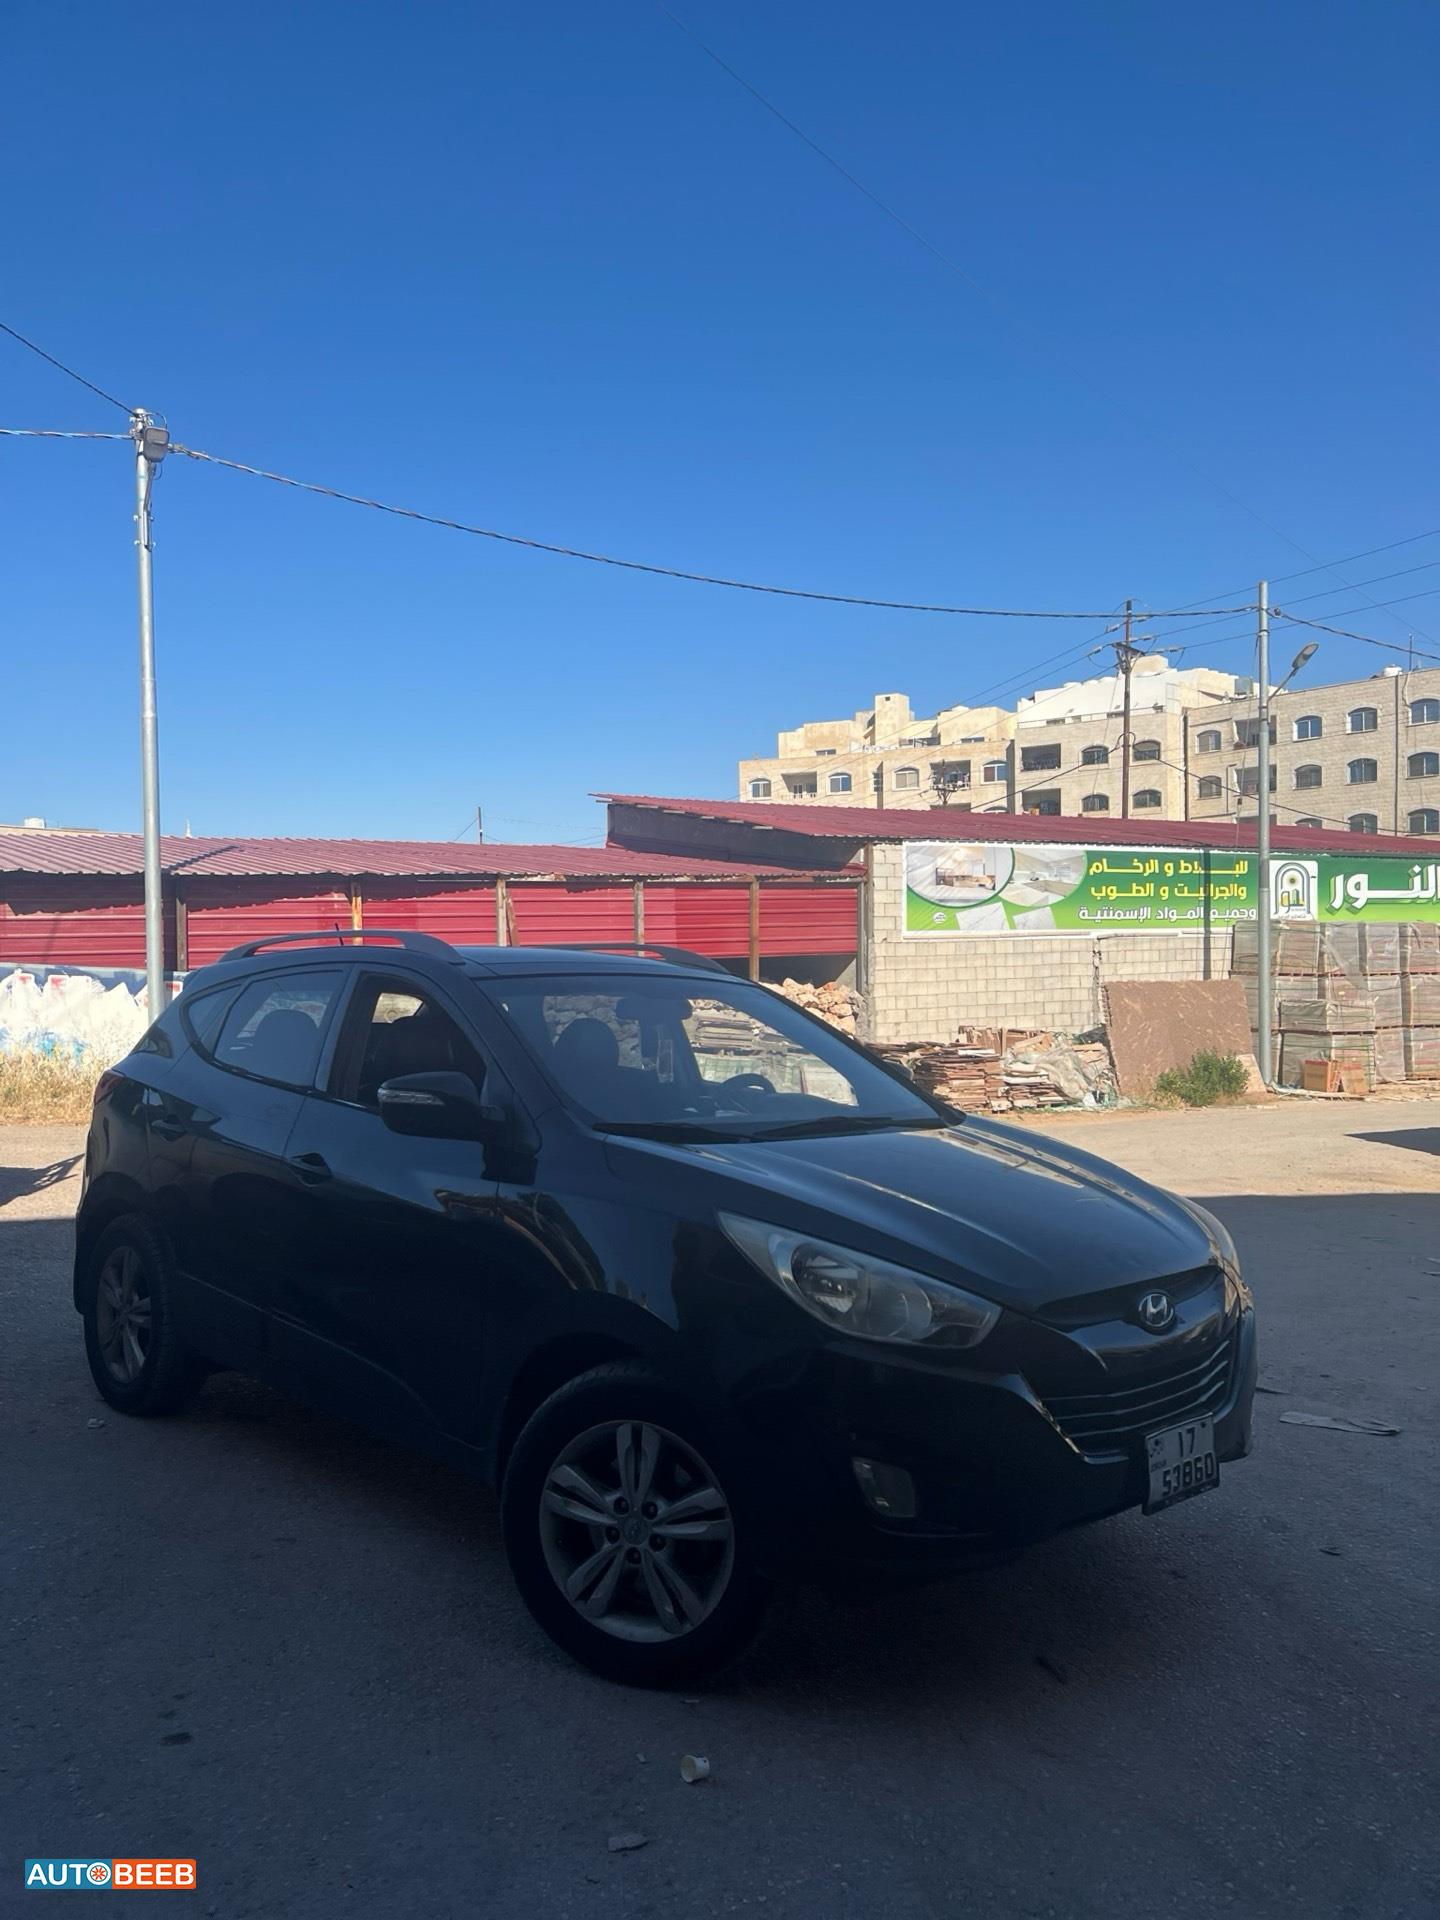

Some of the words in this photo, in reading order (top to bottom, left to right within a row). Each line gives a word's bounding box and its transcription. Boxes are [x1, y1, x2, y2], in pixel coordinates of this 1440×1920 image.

[1089, 858, 1159, 876] الرخام
[1164, 861, 1174, 877] و
[1091, 882, 1154, 900] الطوب
[1159, 885, 1169, 900] و
[1156, 906, 1204, 922] المواد
[1178, 1426, 1196, 1458] 17
[1162, 1451, 1214, 1497] 53860
